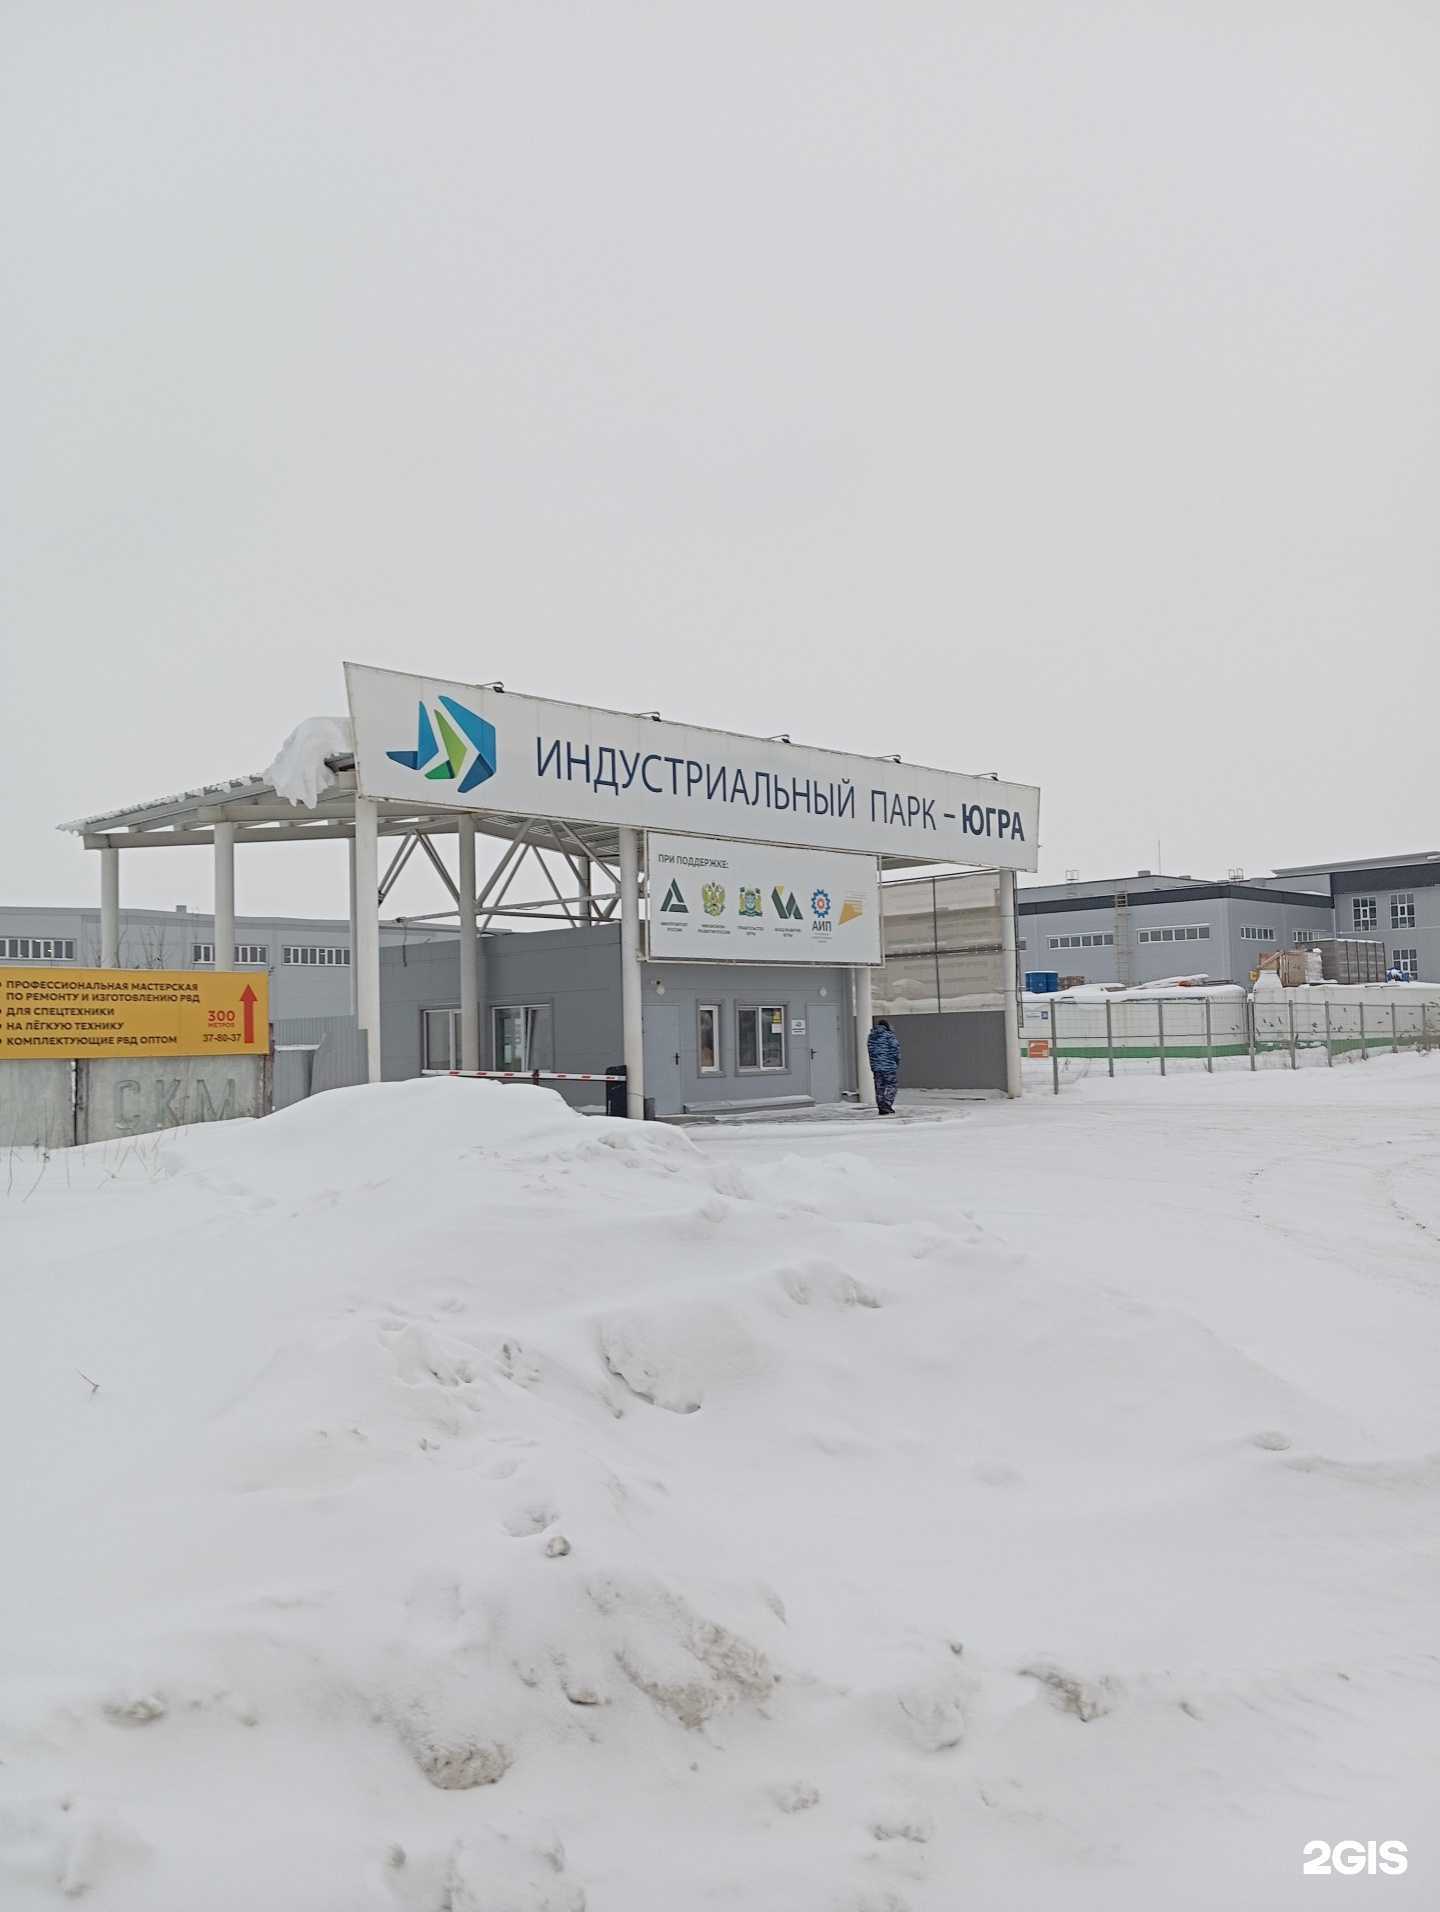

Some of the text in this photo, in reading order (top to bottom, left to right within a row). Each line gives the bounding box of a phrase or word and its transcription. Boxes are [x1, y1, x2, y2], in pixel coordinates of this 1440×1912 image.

[536, 736, 855, 818] ИНДУСТРИАЛЬНЫЙ
[870, 789, 937, 830] ПАРК
[961, 803, 1025, 841] ЮГРА
[658, 854, 729, 869] ПРИ ПОДДЕРЖКЕ:
[812, 920, 832, 932] АИП
[6, 980, 198, 991] ПРОФЕССИОНАЛЬНАЯ МАСТЕРСКАЯ
[6, 993, 23, 1001] ПО
[26, 993, 79, 1001] РЕМОНТУ
[92, 993, 178, 1002] ИЗГОТОВЛЕНИЮ
[180, 994, 200, 1003] РВД
[6, 1007, 114, 1016] ДЛЯ СПЕЦТЕХНИКИ
[208, 1010, 235, 1022] 300
[7, 1020, 124, 1030] НА ЛЁГКУЮ ТЕХНИКУ
[7, 1036, 177, 1046] КОМПЛЕКТУЮЩИЕ РВД ОПТОМ
[114, 1078, 236, 1129] СКМ
